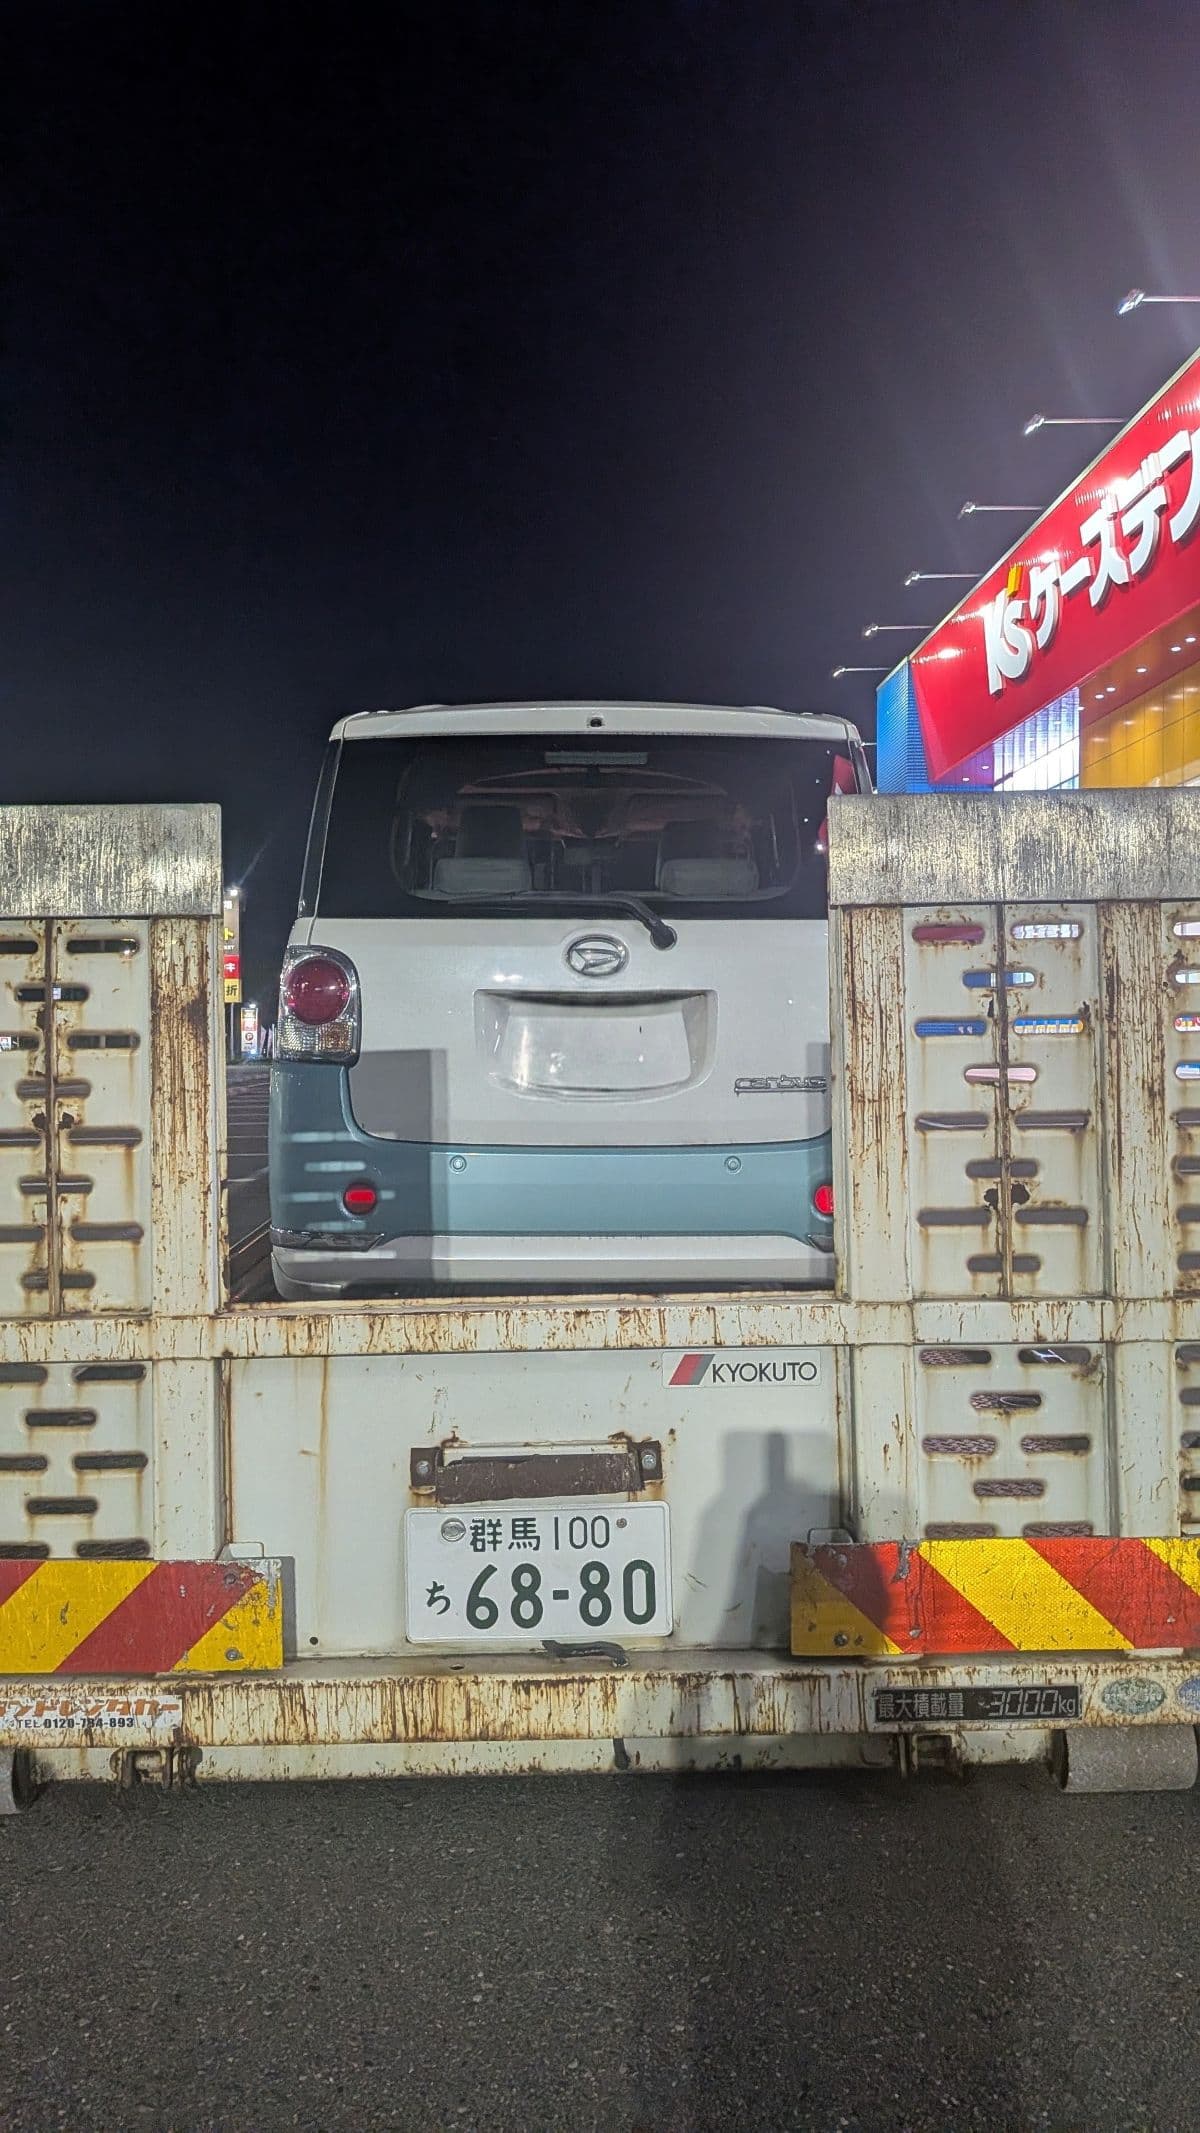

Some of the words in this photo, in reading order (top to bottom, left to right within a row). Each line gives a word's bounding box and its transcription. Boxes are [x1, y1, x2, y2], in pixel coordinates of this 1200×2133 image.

[712, 1360, 818, 1383] KYOKUTO
[425, 1580, 452, 1615] ち
[465, 1558, 657, 1630] 68-80
[878, 1692, 965, 1718] 最大積載量
